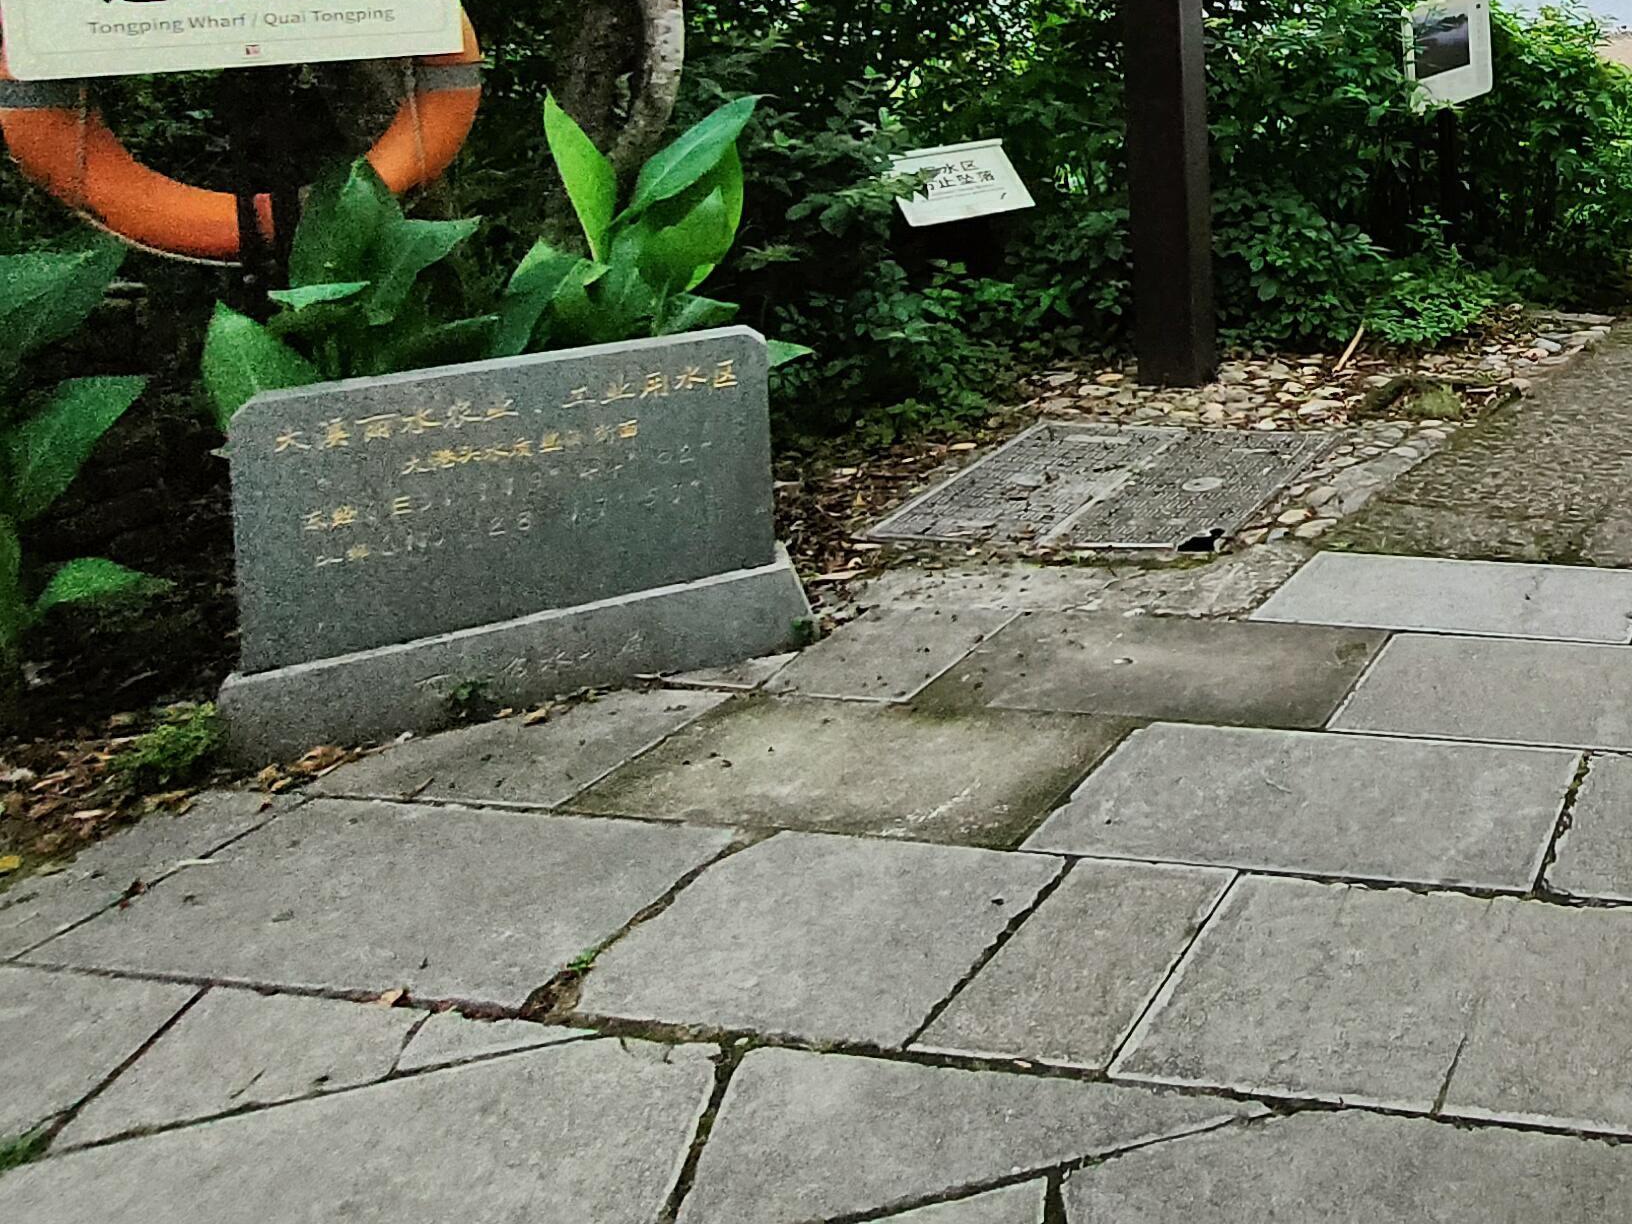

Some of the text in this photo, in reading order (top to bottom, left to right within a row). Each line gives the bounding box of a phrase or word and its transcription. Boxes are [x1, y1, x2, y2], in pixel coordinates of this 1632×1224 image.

[88, 18, 185, 36] Tongping
[188, 13, 247, 30] Wharf
[263, 10, 307, 27] Quai
[311, 6, 397, 25] Tongping
[938, 160, 980, 175] 水区
